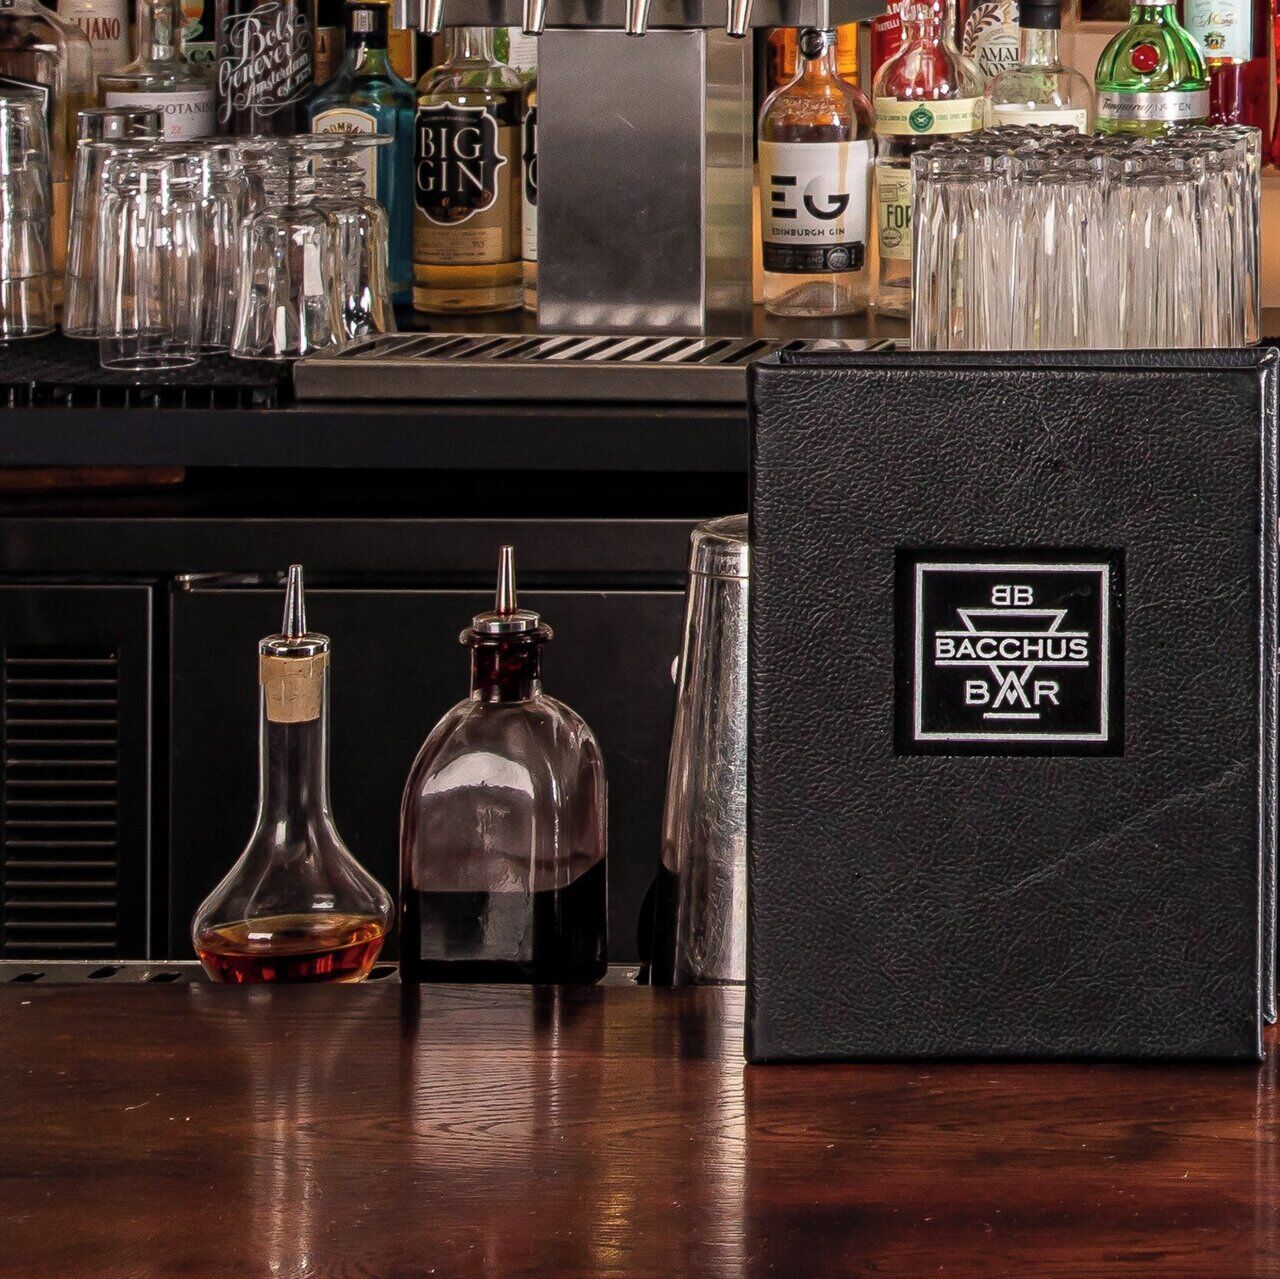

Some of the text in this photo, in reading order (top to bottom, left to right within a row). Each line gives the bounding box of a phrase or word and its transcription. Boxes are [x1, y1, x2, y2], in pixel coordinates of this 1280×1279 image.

[979, 47, 1020, 63] AMA
[420, 127, 482, 159] BIG
[416, 160, 486, 193] GIN
[770, 176, 851, 220] EG
[770, 227, 847, 238] EDINBURGH GIN
[935, 636, 1090, 660] BACCHUS
[964, 671, 1060, 709] BAR
